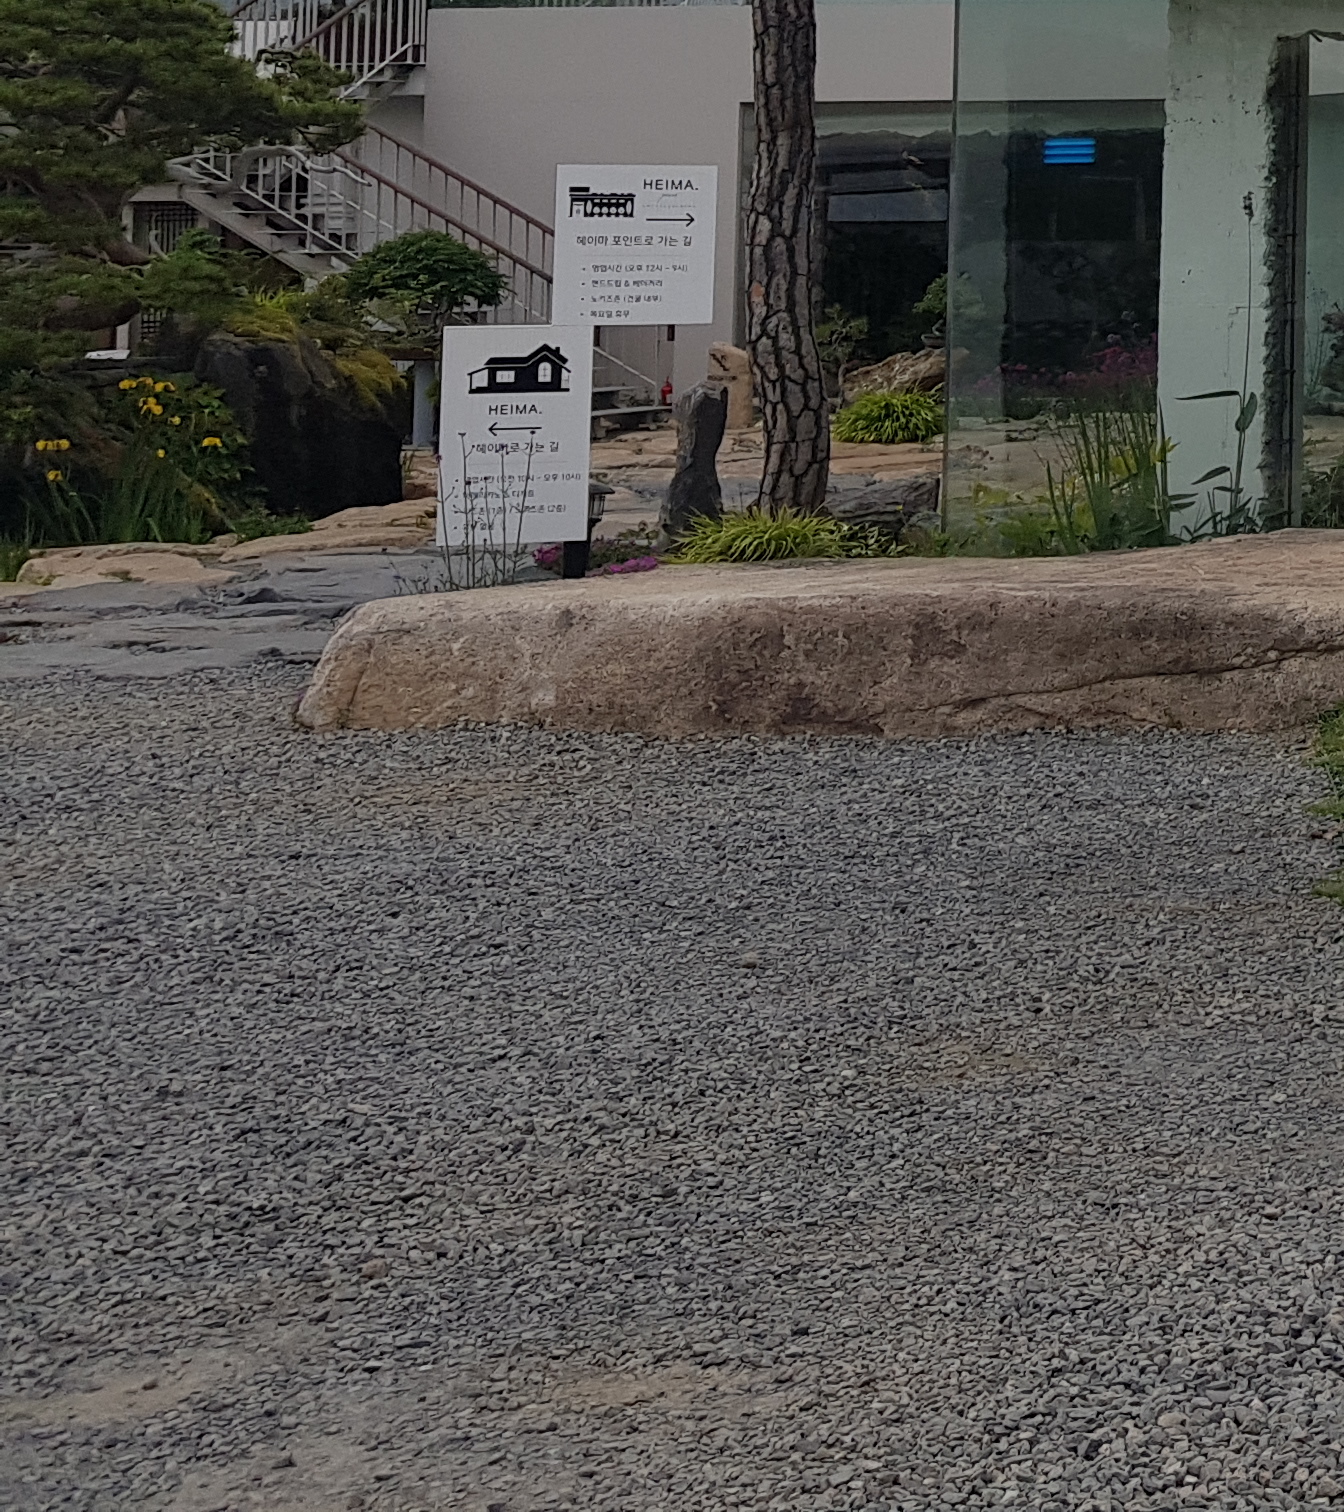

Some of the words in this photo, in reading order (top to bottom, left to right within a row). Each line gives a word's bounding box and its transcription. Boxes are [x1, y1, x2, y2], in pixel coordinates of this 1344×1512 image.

[643, 178, 699, 191] HEIMA.
[576, 235, 608, 247] 헤이마
[611, 235, 654, 247] 포인트로
[657, 235, 679, 247] 가는
[682, 235, 692, 247] 길
[591, 264, 622, 273] 영업시간
[488, 403, 543, 416] HEIMA.
[549, 441, 560, 453] 길
